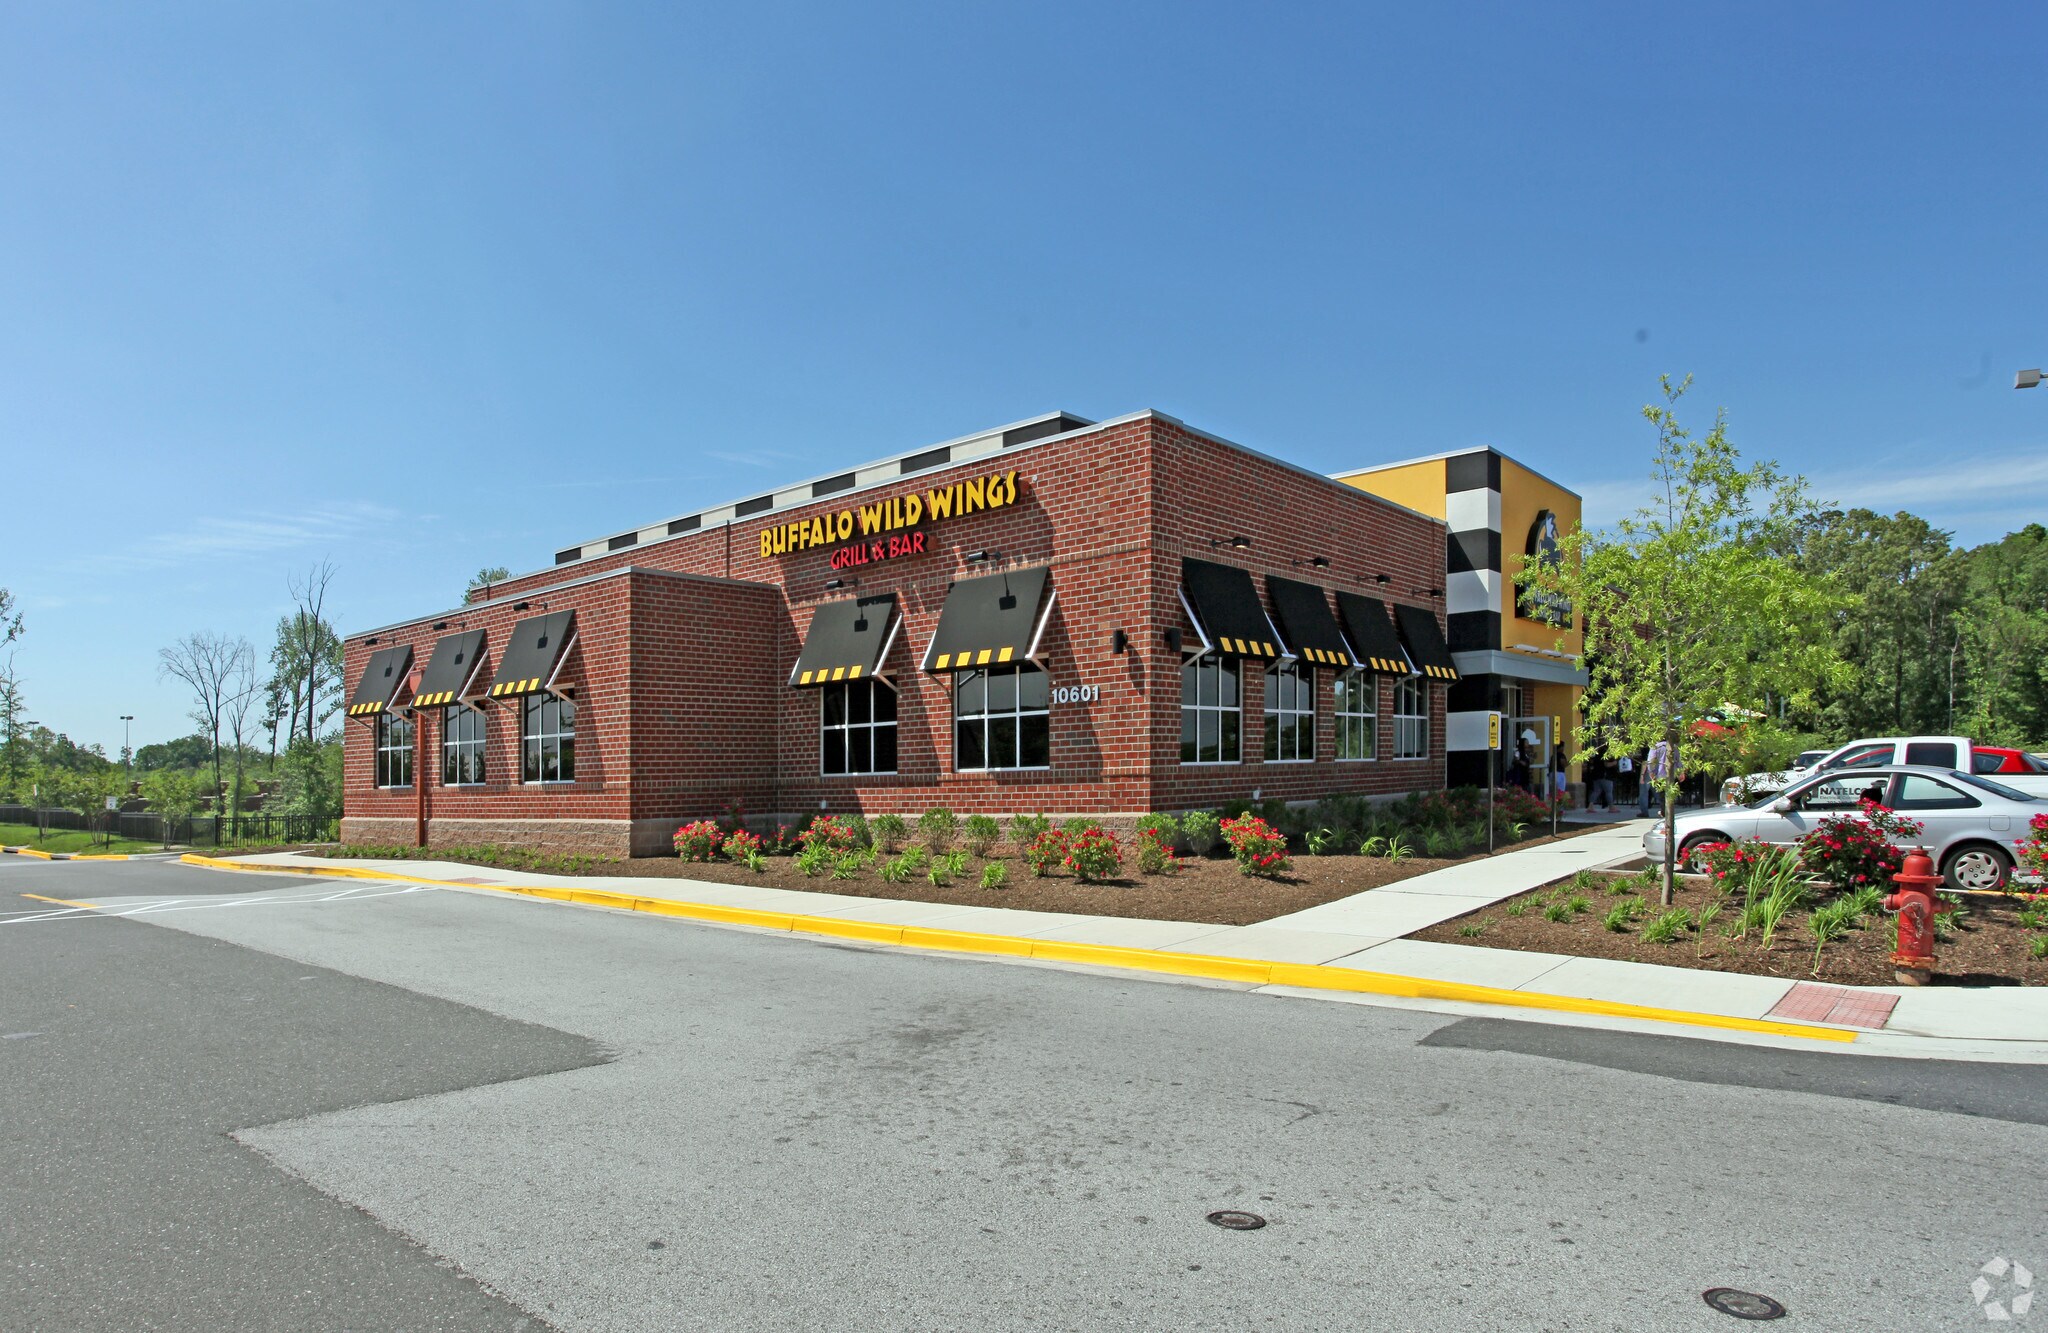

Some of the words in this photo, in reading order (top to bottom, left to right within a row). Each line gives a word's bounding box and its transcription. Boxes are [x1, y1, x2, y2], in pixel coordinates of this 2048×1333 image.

[760, 510, 854, 558] BUFFALO
[859, 494, 923, 535] WILD
[928, 470, 1019, 521] WINGS
[830, 543, 869, 570] GRILL
[871, 539, 885, 560] &
[889, 531, 924, 556] BAR
[1051, 684, 1099, 704] 10601
